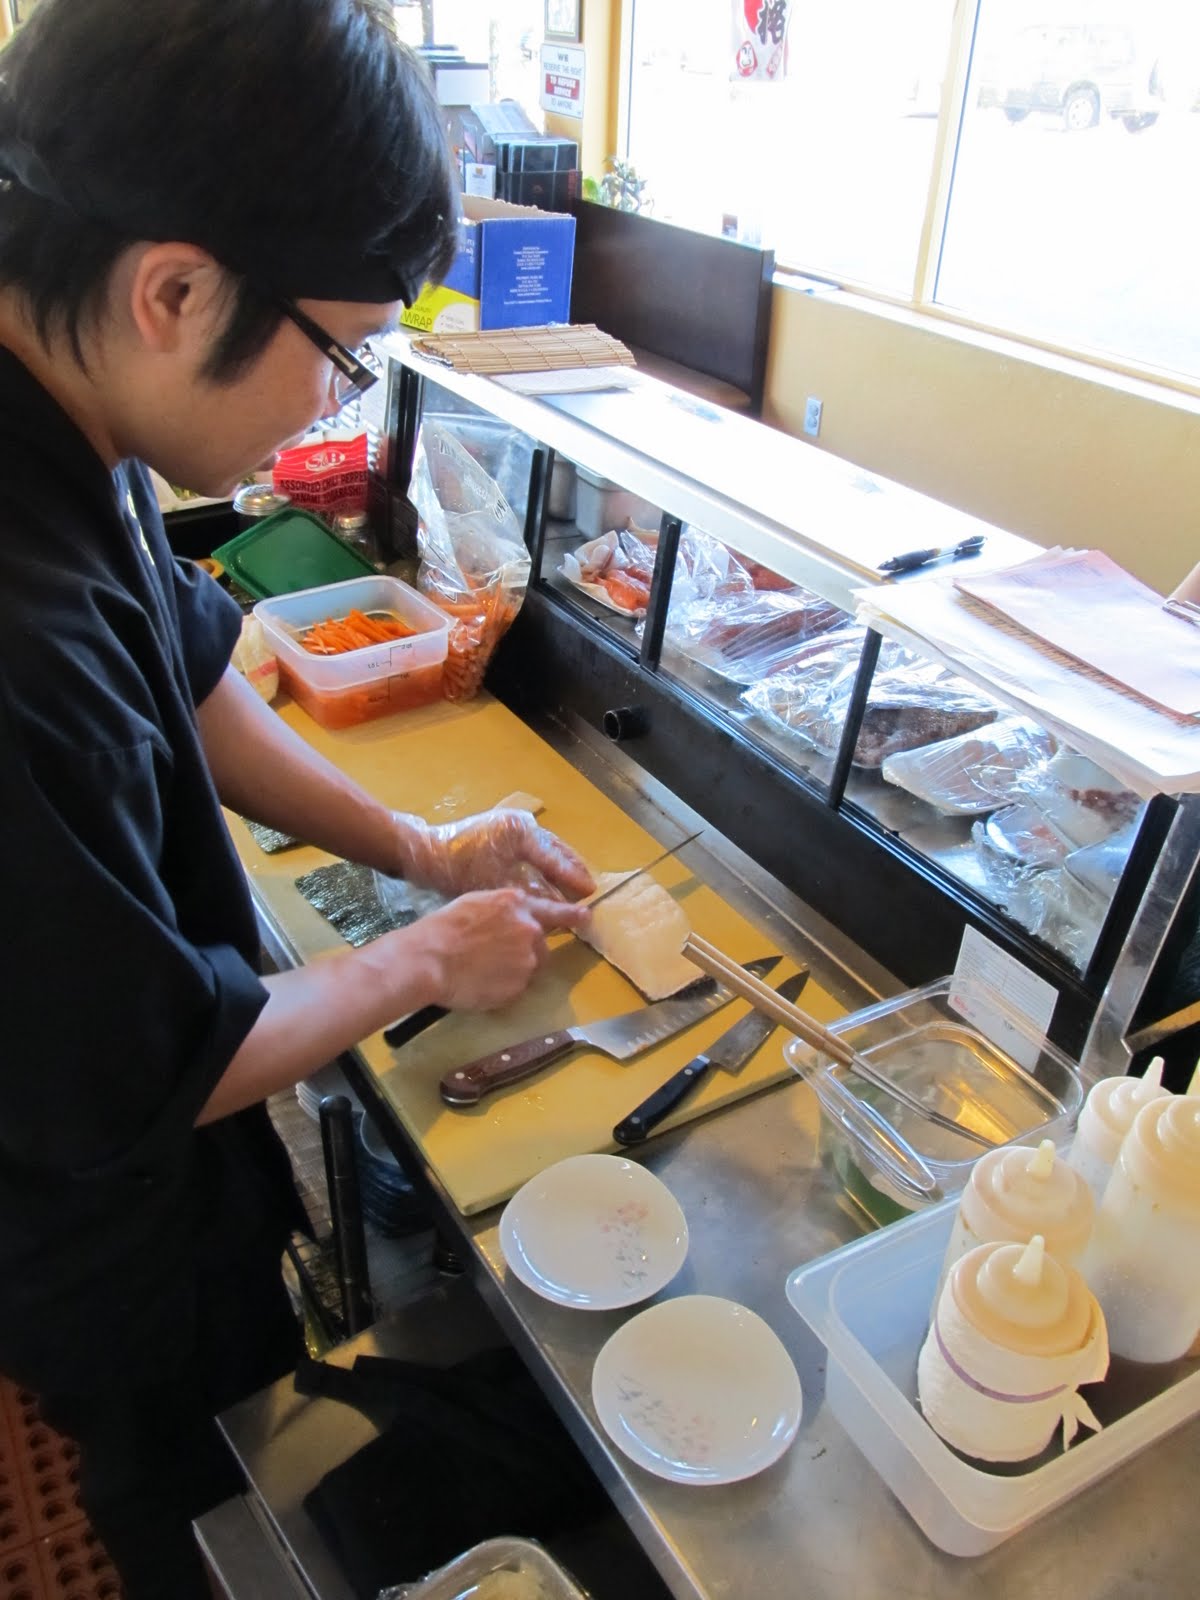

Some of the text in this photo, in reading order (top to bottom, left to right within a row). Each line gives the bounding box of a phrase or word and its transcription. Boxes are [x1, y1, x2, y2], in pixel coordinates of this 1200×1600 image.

[557, 53, 569, 62] WE
[562, 65, 570, 73] THE
[550, 75, 557, 84] TO
[404, 310, 433, 329] WRAP
[280, 479, 321, 493] ASSORTED
